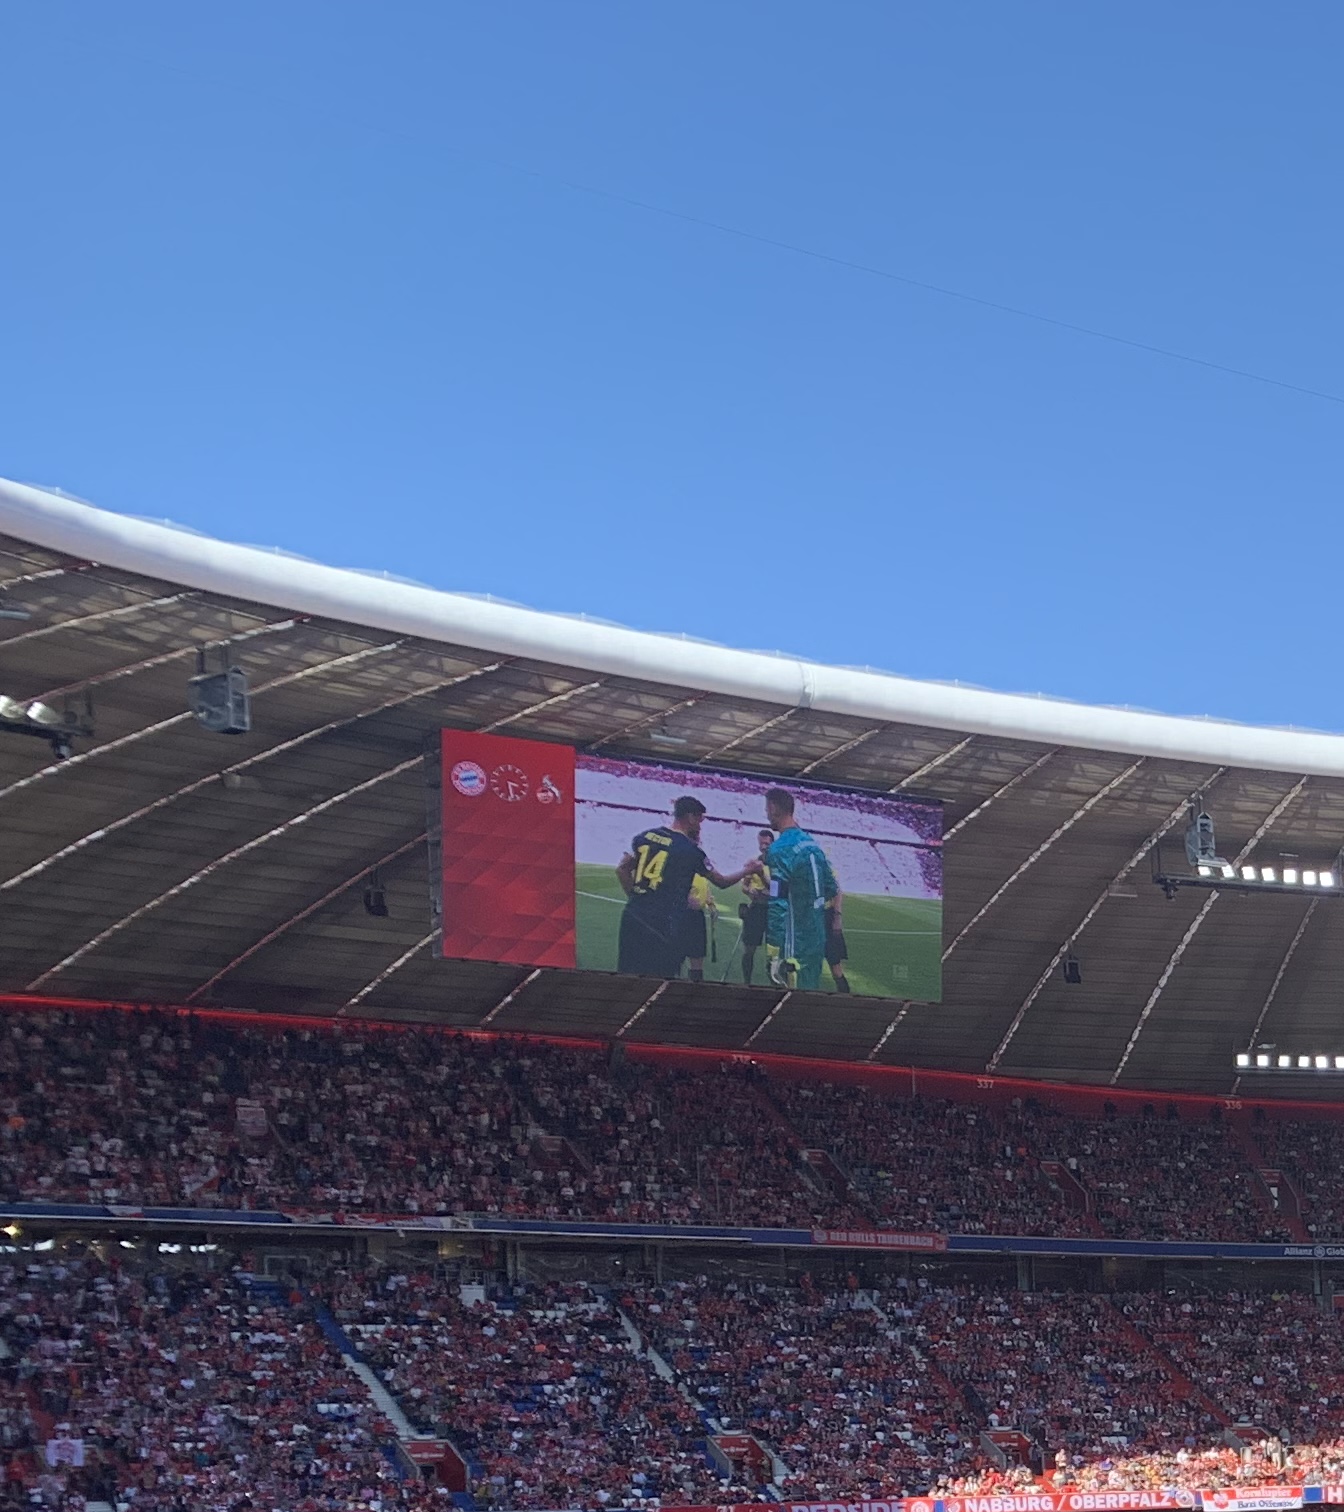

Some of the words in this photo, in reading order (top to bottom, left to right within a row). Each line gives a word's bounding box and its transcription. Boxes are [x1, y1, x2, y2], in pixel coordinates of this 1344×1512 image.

[634, 844, 669, 885] 14
[1283, 1247, 1313, 1256] Allianz
[1072, 1489, 1172, 1509] OBERPFALZ
